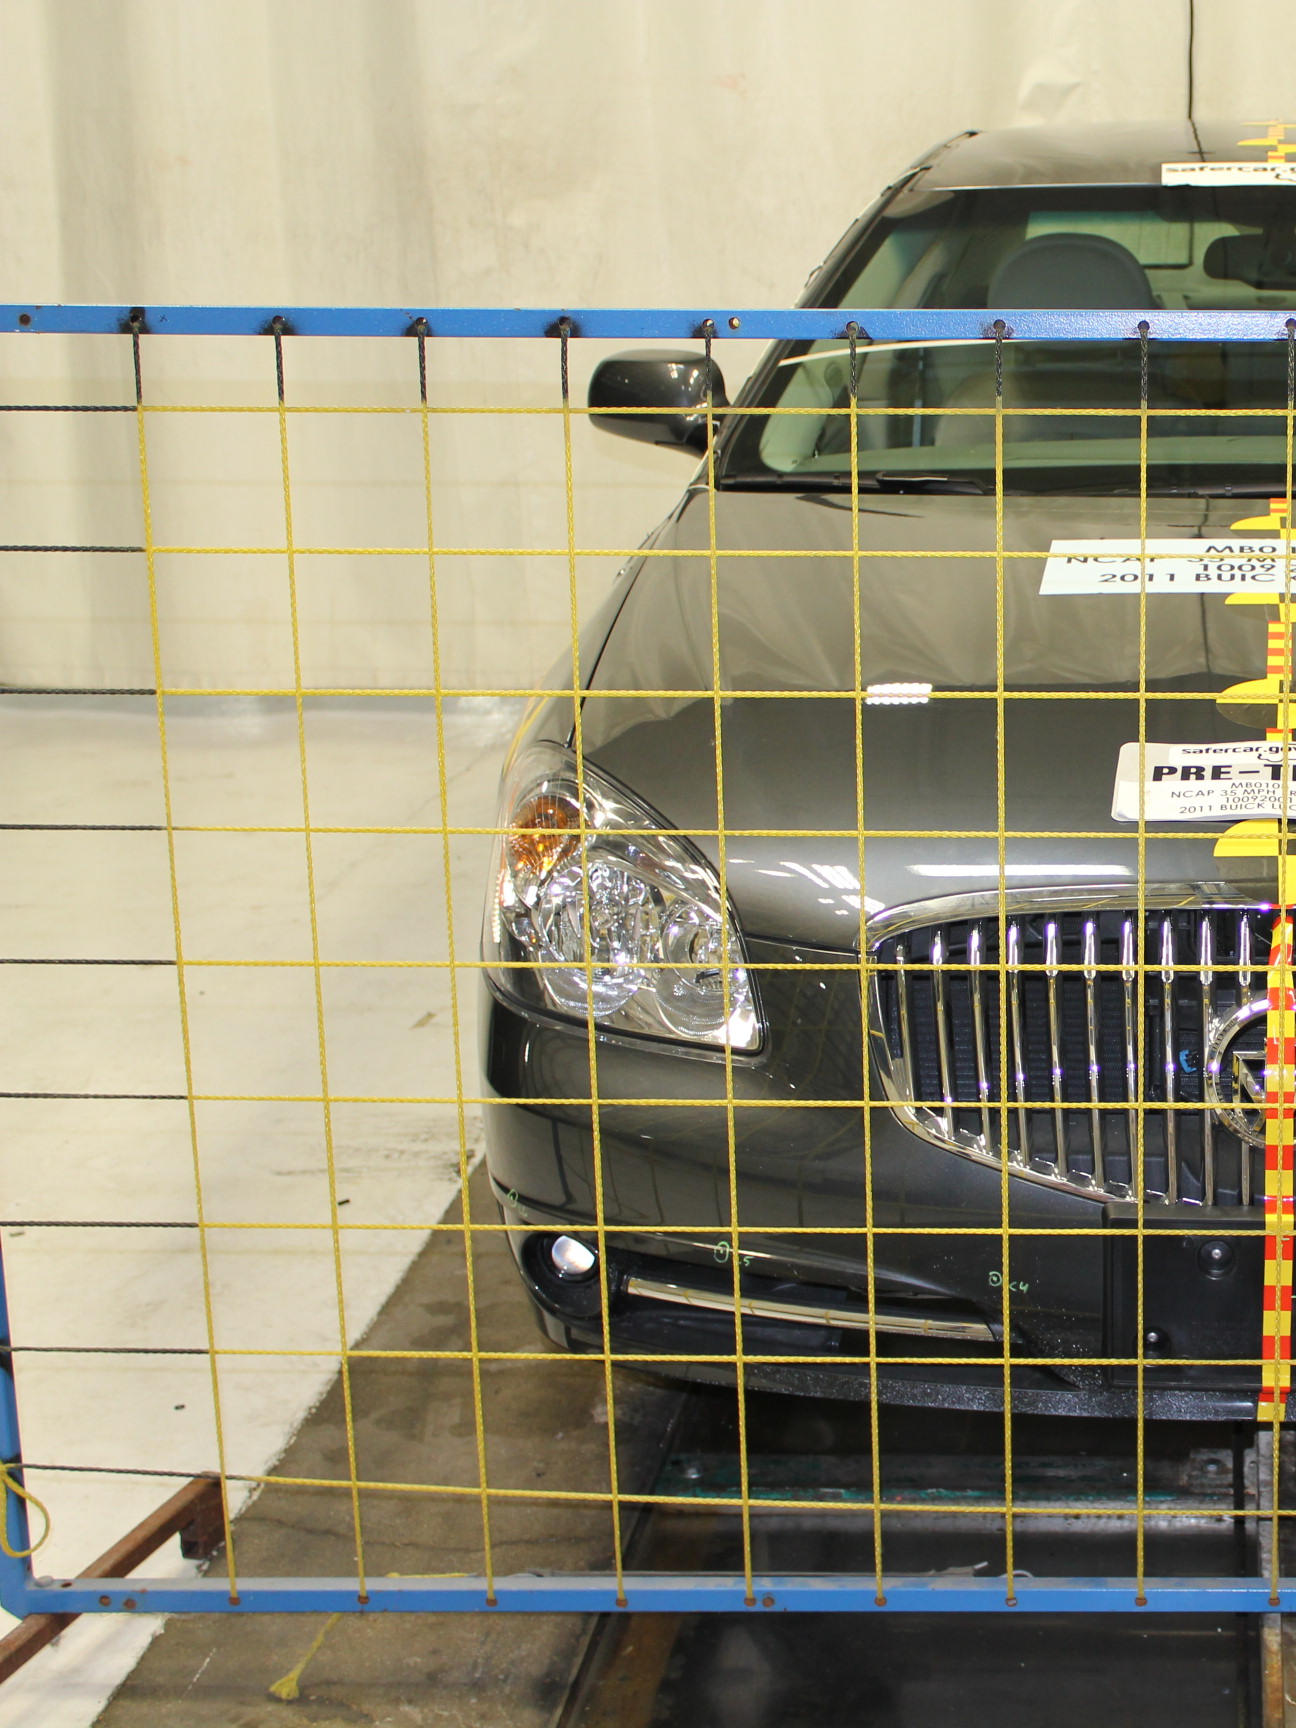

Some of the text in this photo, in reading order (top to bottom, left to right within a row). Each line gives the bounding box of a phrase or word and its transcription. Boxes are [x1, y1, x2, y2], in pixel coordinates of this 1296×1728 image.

[1097, 573, 1176, 583] 2011
[1230, 782, 1285, 790] MB010
[1171, 790, 1215, 798] NCAP
[1242, 788, 1276, 796] MPH
[1179, 805, 1213, 814] 2011
[1220, 802, 1266, 811] BUICK
